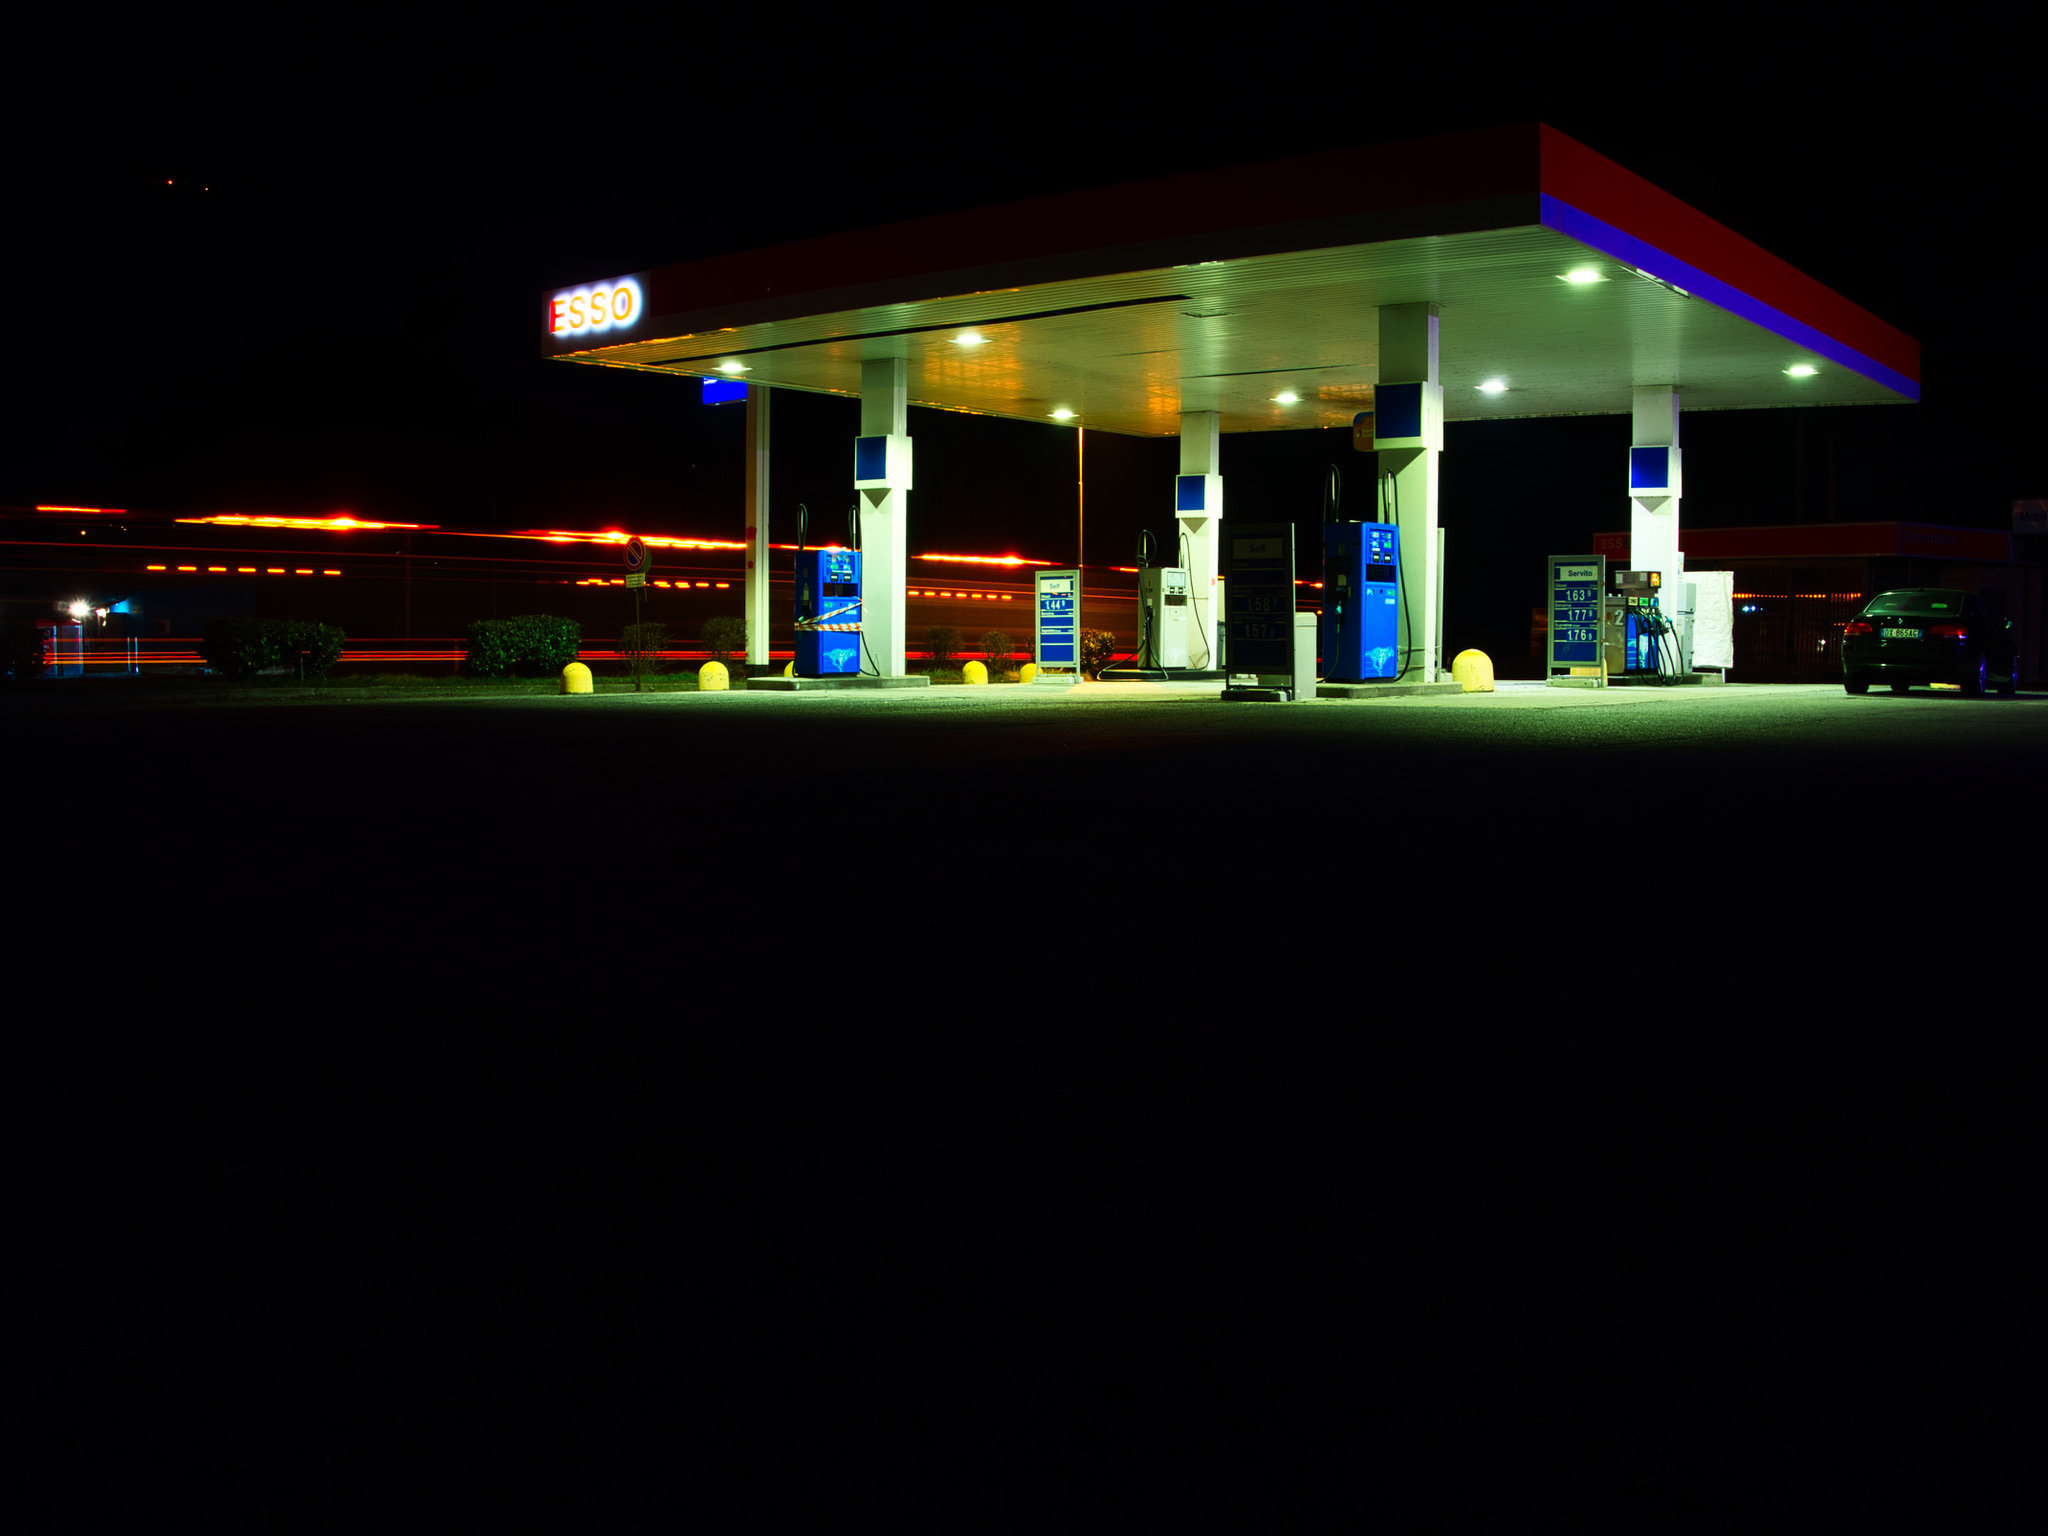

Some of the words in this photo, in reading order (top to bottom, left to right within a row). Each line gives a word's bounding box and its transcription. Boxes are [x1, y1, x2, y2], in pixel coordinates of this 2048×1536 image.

[549, 286, 633, 335] ESSO
[1249, 544, 1266, 553] Self
[1567, 569, 1593, 577] Servito
[1614, 609, 1625, 626] 2
